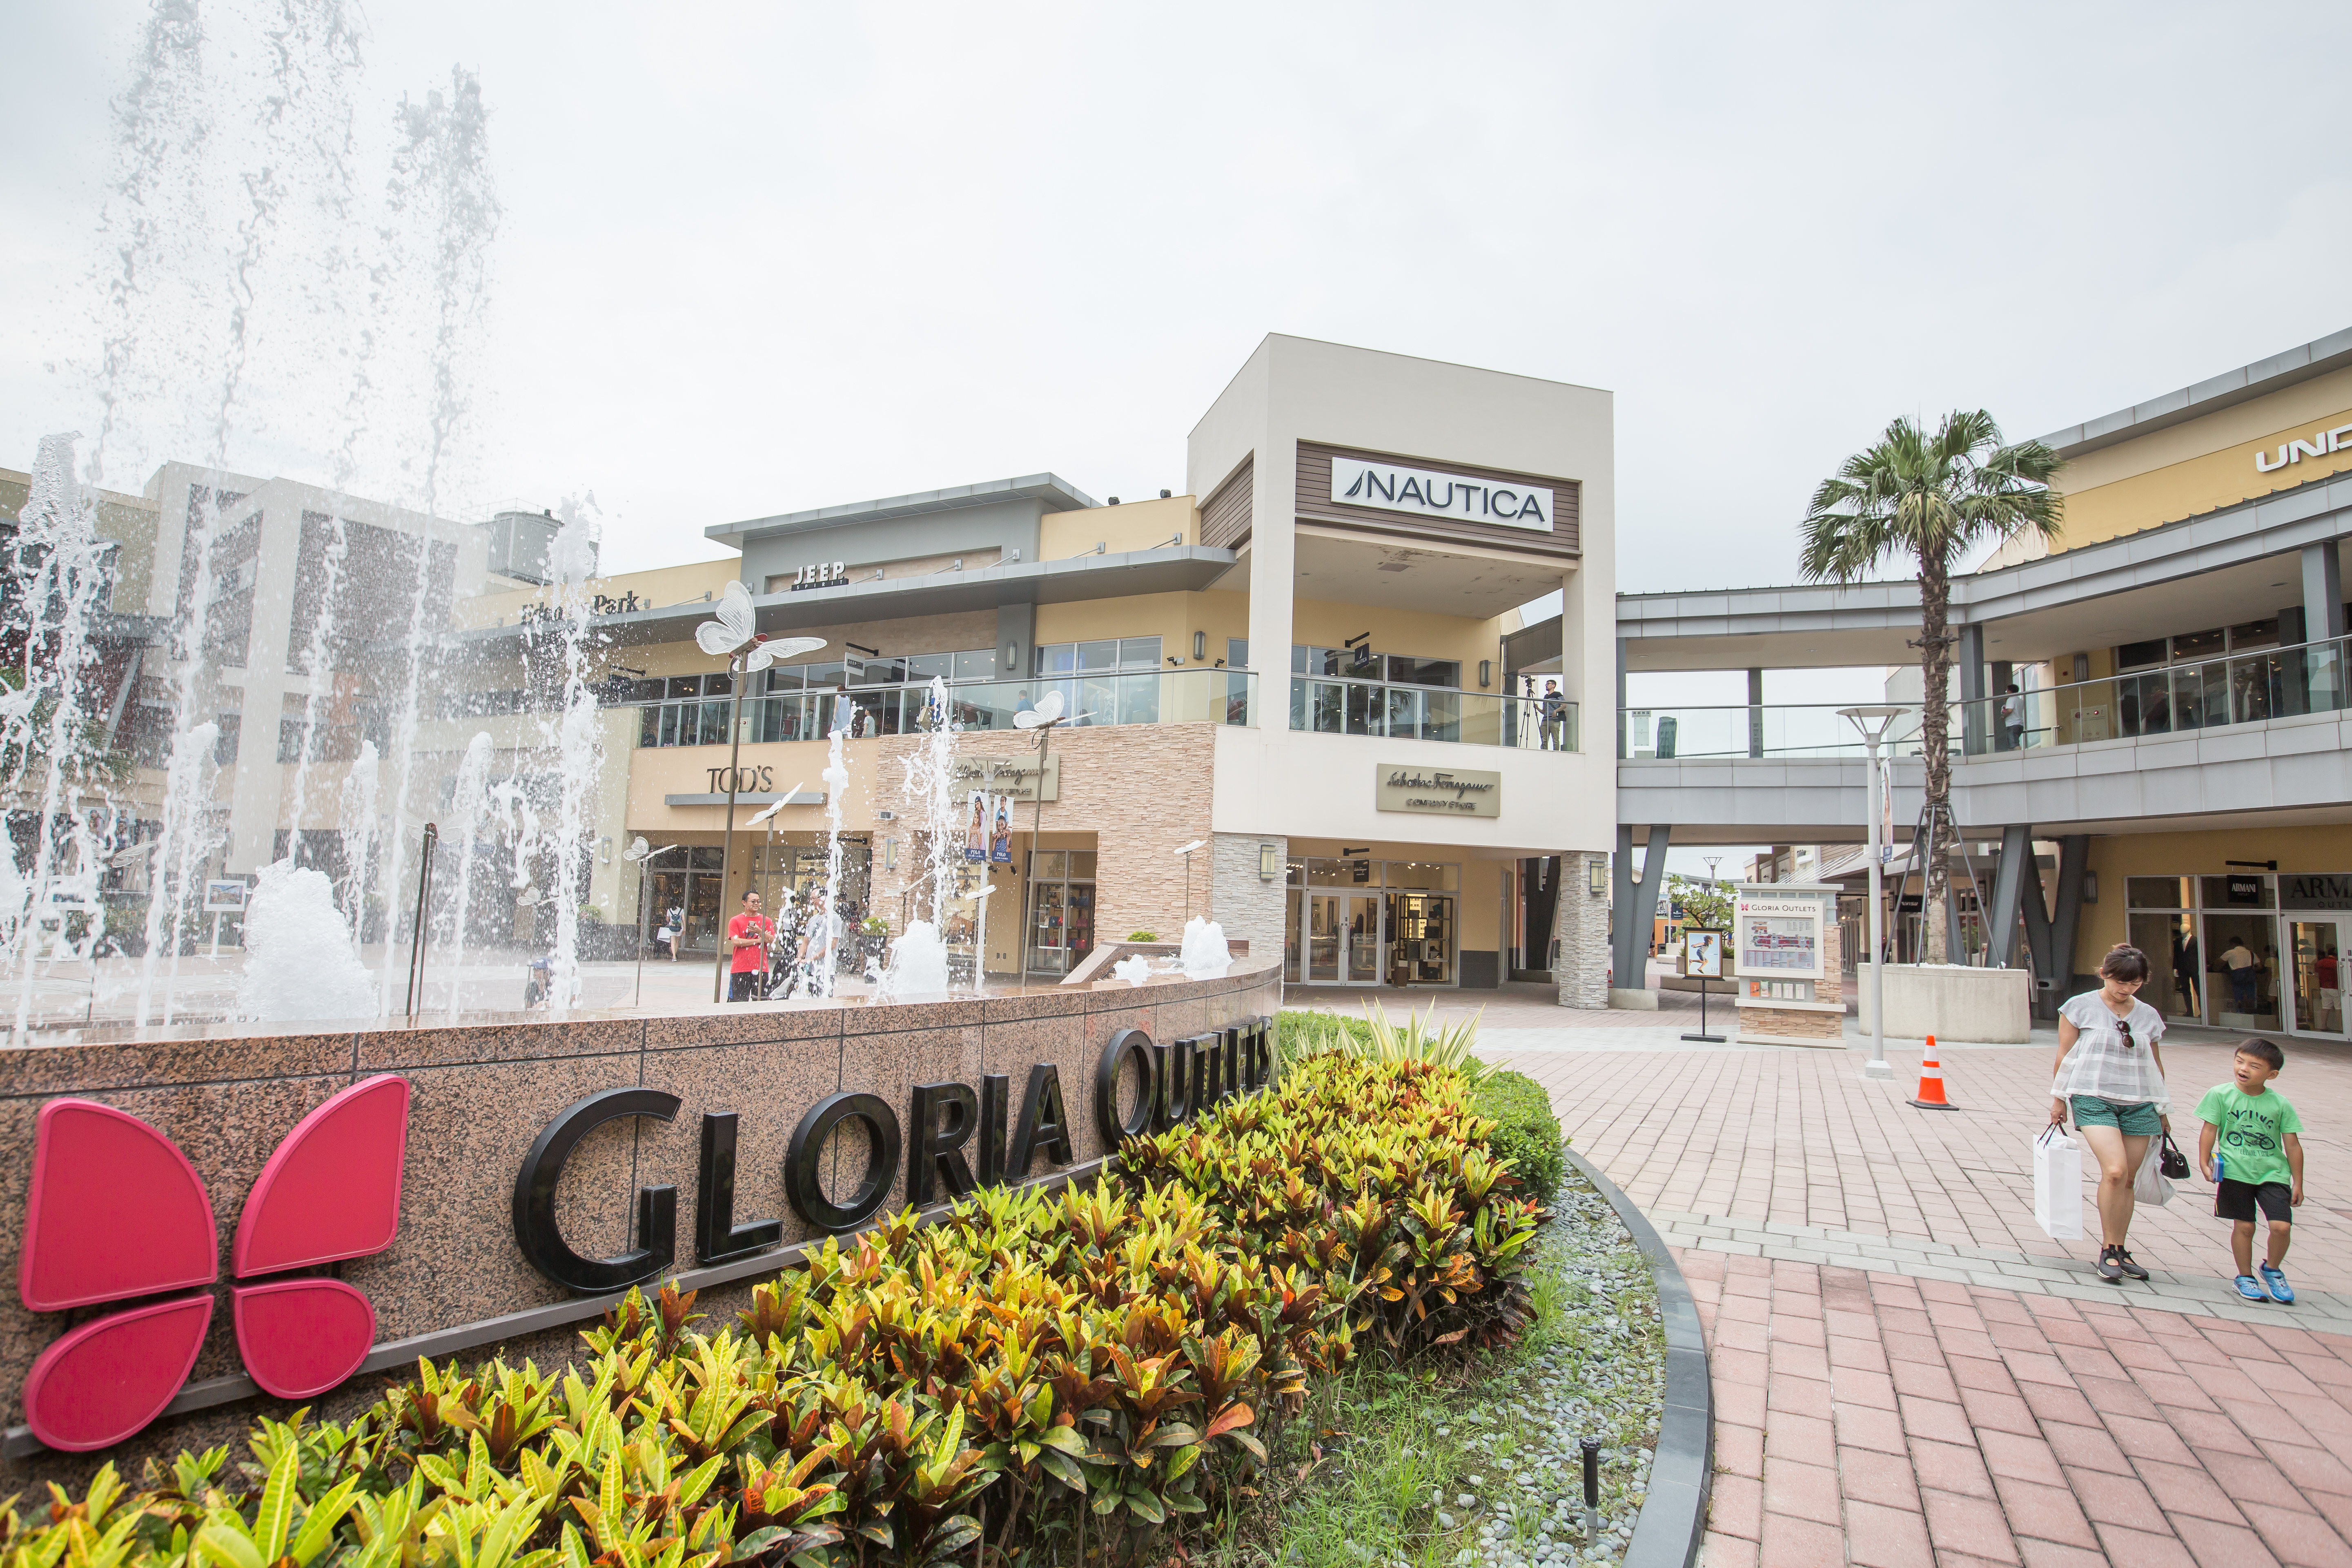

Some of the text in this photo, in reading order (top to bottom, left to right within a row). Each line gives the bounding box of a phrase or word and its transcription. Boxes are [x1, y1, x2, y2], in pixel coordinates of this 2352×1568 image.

[1367, 470, 1545, 522] NAUTICA
[793, 561, 845, 585] JEEP
[796, 579, 843, 590] SPIRIT
[593, 590, 639, 616] Park
[1355, 657, 1367, 666] NAUTICA
[706, 765, 773, 793] TOD'S
[1406, 798, 1477, 809] COMPANY STORE
[2232, 883, 2256, 893] ARMANI
[2290, 878, 2352, 898] ARM
[2226, 1109, 2274, 1131] CYCLING
[513, 1063, 1073, 1292] GLORIA
